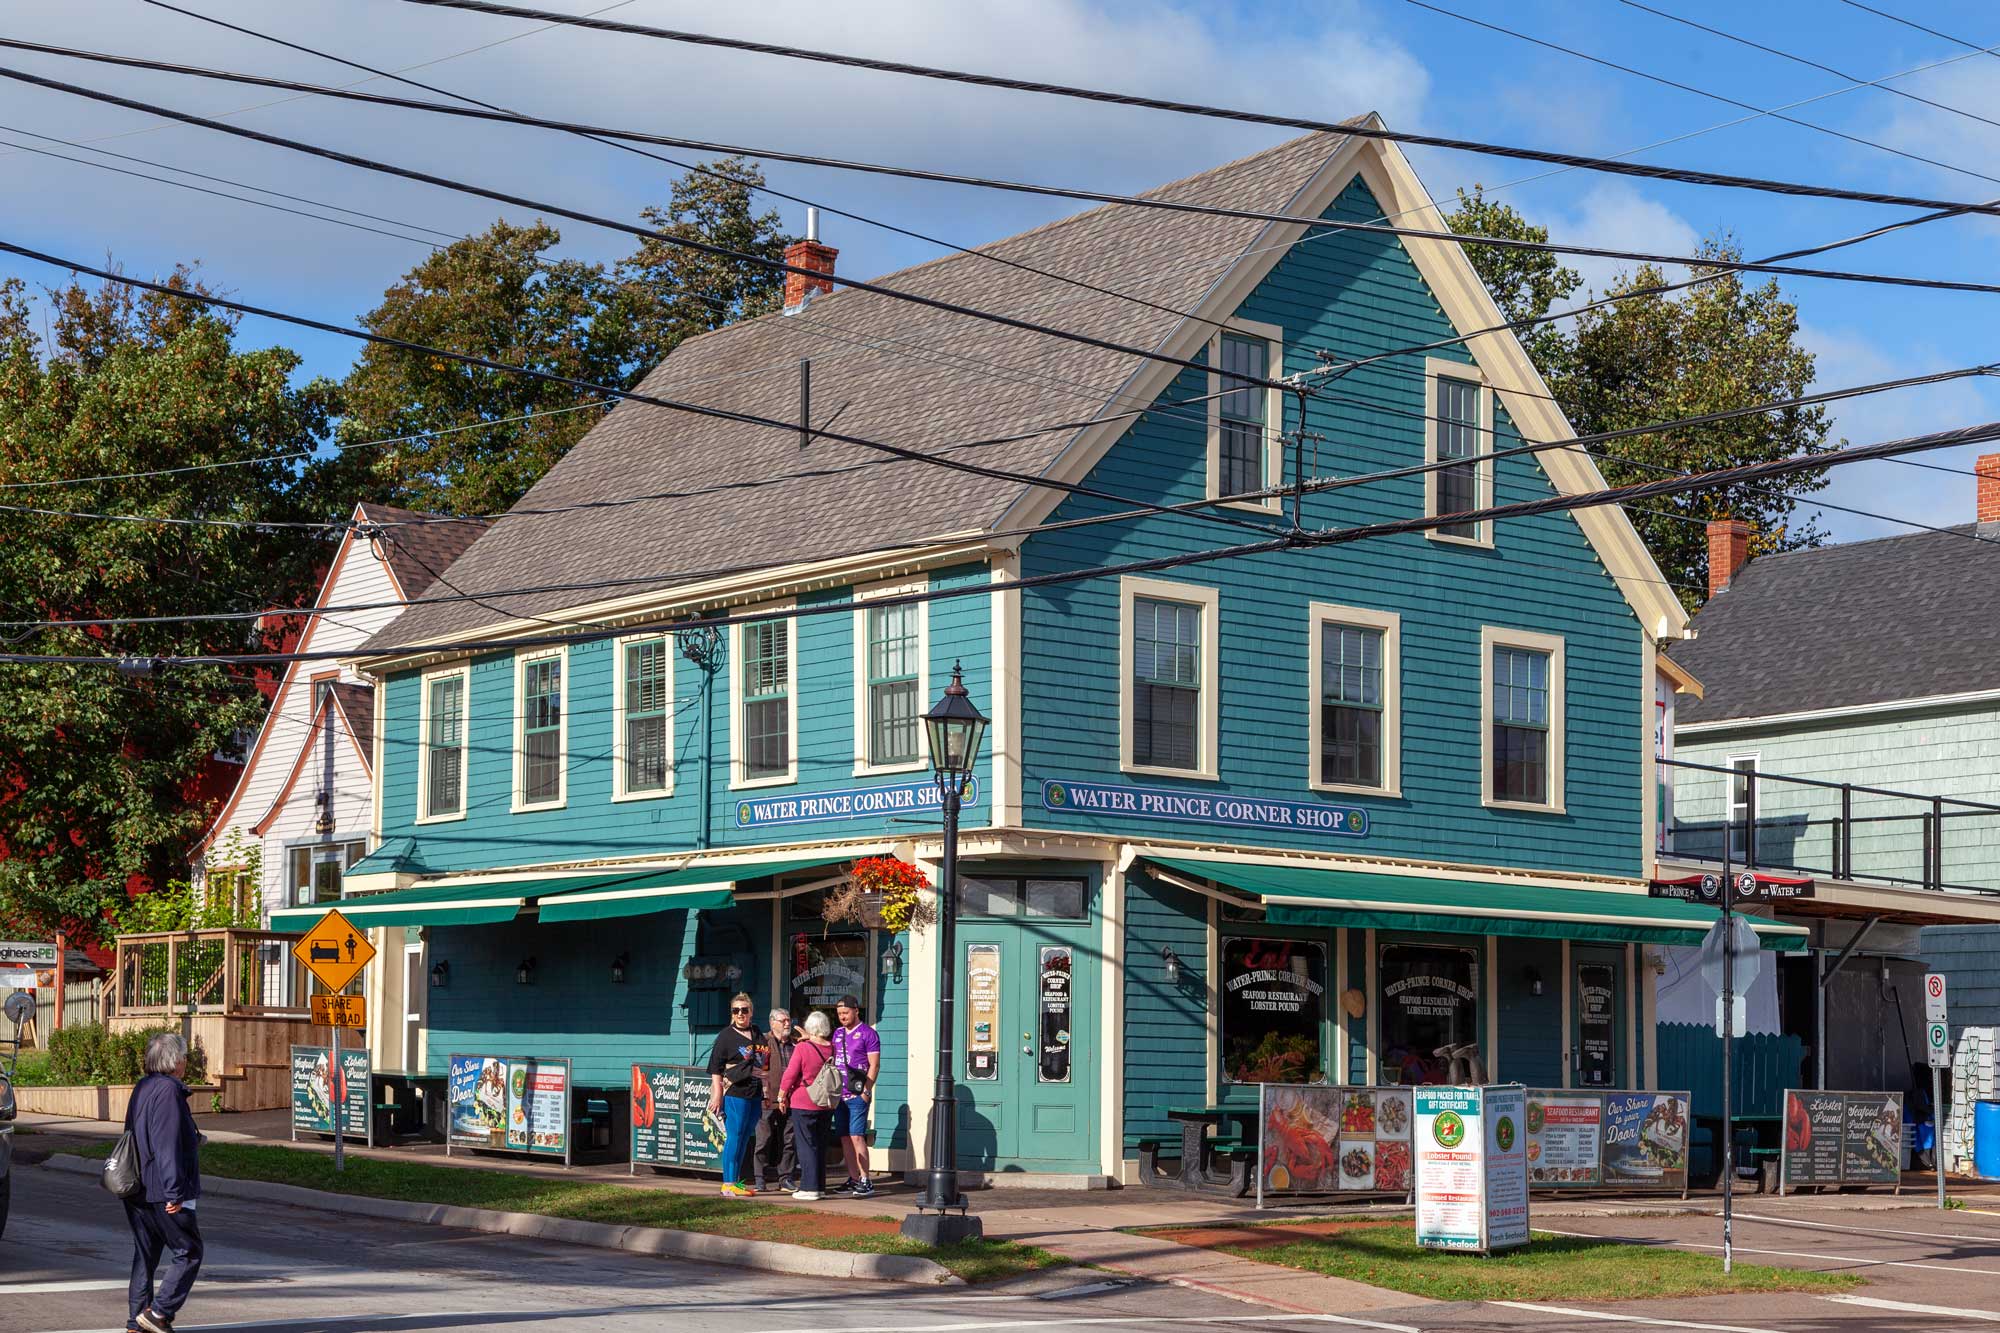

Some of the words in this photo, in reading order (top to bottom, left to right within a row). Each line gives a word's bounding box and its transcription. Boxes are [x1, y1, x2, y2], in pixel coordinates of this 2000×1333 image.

[754, 802, 798, 821] WATER
[800, 796, 852, 817] PRINCE
[854, 789, 915, 810] CORNER
[1070, 788, 1137, 810] WATER
[1141, 794, 1211, 817] PRINCE
[1215, 801, 1293, 824] CORNER
[1296, 808, 1344, 829] SHOP
[1669, 885, 1689, 897] PRINCE
[1769, 884, 1795, 896] WATER
[1225, 970, 1277, 993] WATER-PRINCE
[1278, 971, 1305, 987] CORNER
[1305, 978, 1324, 997] SHOP
[1384, 976, 1430, 998] WATER-PRINCE
[1431, 976, 1457, 992] CORNER
[1456, 984, 1474, 1001] SHOP
[1242, 990, 1267, 1000] SEAFOOD
[1267, 991, 1310, 1002] RESTAURANT
[1399, 995, 1422, 1004] SEAFOOD
[1422, 996, 1460, 1007] RESTAURANT
[322, 998, 352, 1010] SHARE
[1250, 1001, 1277, 1011] LOBSTER
[1278, 1002, 1300, 1011] POUND
[1407, 1006, 1432, 1015] LOBSTER
[1432, 1006, 1453, 1016] POUND
[315, 1012, 331, 1024] THE
[336, 1013, 360, 1025] ROAD
[1044, 1045, 1066, 1053] Welcome
[451, 1063, 463, 1077] Our
[463, 1060, 480, 1073] Shore
[463, 1074, 474, 1086] your
[652, 1072, 680, 1089] Lobster
[452, 1082, 476, 1103] Door!
[655, 1087, 680, 1101] Pound
[684, 1081, 711, 1098] Seafoo
[1416, 1091, 1437, 1100] SEAFOOD
[1437, 1091, 1454, 1100] PACKED
[1454, 1091, 1463, 1100] FOR
[1463, 1091, 1479, 1100] TRAVEL
[684, 1096, 708, 1108] Packed
[1428, 1101, 1438, 1109] GIFT
[1439, 1101, 1468, 1110] CERTIFICATES
[1608, 1102, 1624, 1116] Our
[1625, 1098, 1648, 1111] Shore
[1810, 1099, 1842, 1111] Lobster
[684, 1107, 703, 1119] Travel
[1546, 1107, 1568, 1117] SEAFOOD
[1568, 1107, 1599, 1117] RESTAURANT
[1812, 1111, 1842, 1124] Pound
[1847, 1105, 1879, 1120] Seafood
[1615, 1115, 1622, 1124] to
[1624, 1112, 1640, 1125] your
[1847, 1120, 1870, 1130] Packed
[1606, 1119, 1641, 1144] Door!
[1847, 1130, 1867, 1140] Travel
[1452, 1153, 1472, 1161] Pound
[1424, 1238, 1446, 1248] Fresh
[1447, 1239, 1480, 1249] Seafood
